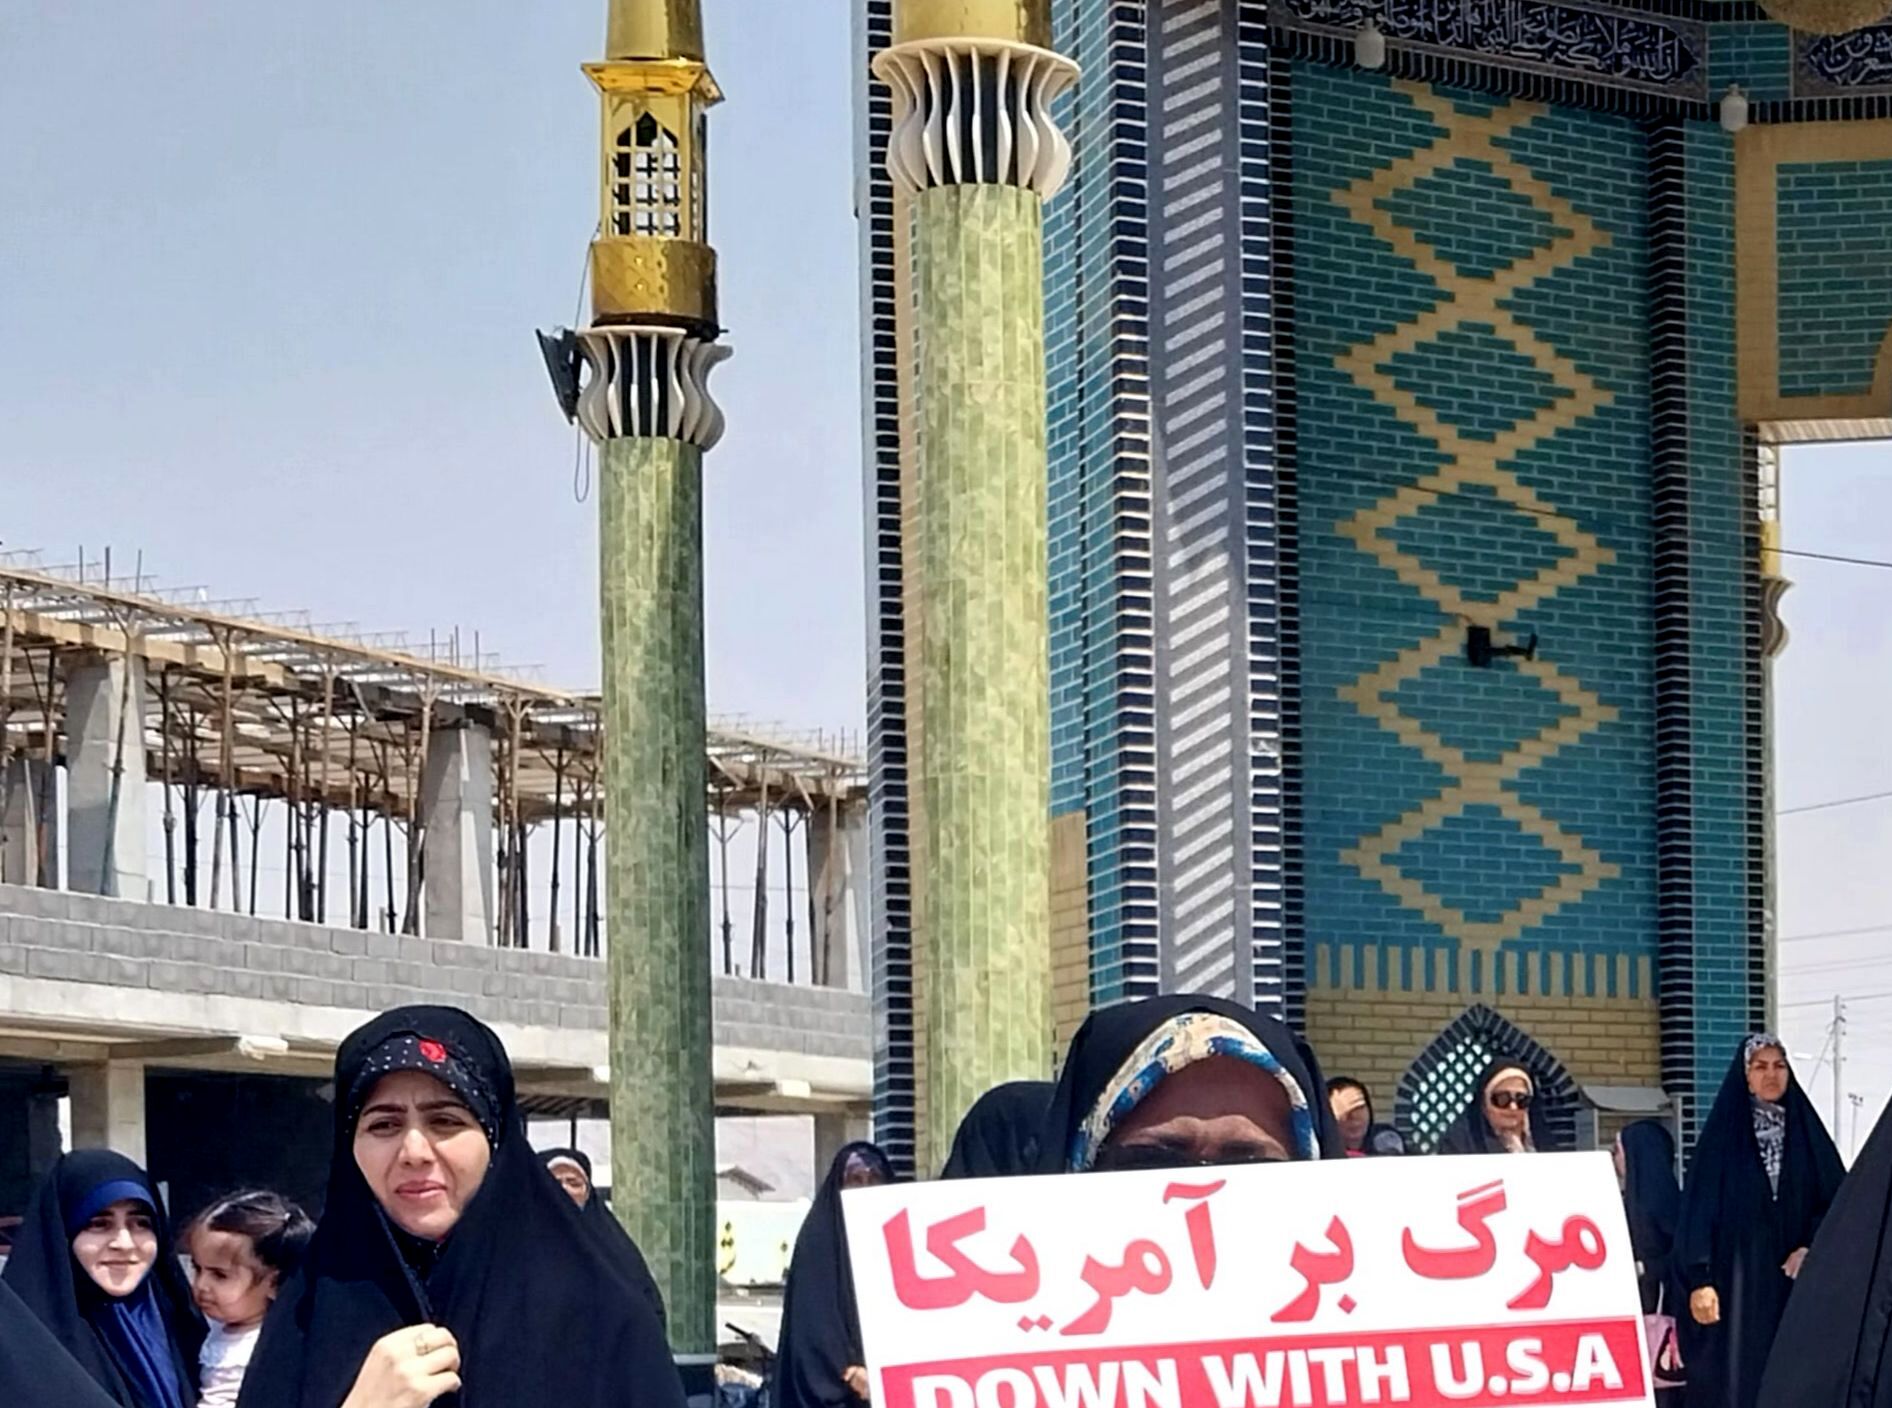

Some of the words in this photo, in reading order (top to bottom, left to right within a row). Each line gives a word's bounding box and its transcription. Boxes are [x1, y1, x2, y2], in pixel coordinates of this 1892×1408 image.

[882, 1179, 1226, 1336] آمریکا
[1270, 1214, 1355, 1323] بر
[1402, 1180, 1607, 1311] مرگ
[1430, 1333, 1624, 1399] U.S.A
